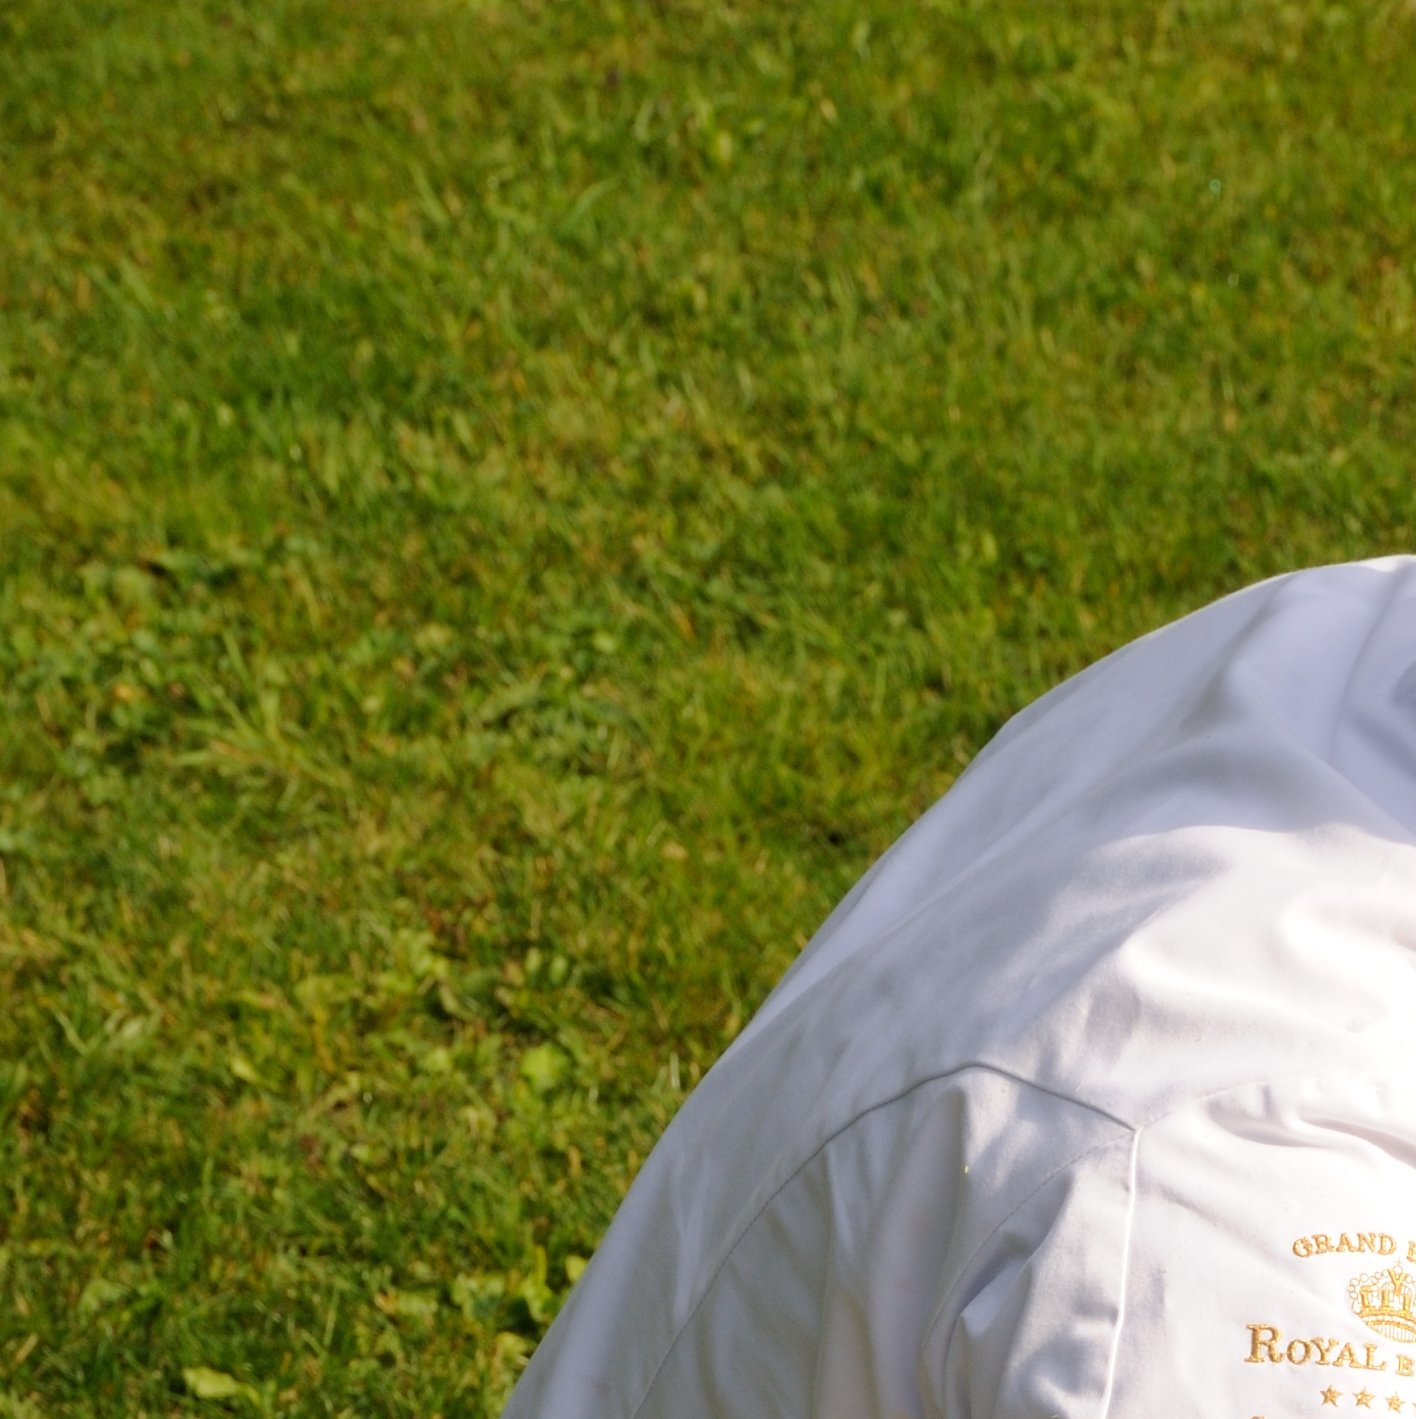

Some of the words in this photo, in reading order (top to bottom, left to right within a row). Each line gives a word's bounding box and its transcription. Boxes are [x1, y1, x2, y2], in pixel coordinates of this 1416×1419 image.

[1291, 1232, 1397, 1258] GRAND
[1244, 1323, 1387, 1372] ROYAL
[1395, 1354, 1416, 1378] E
